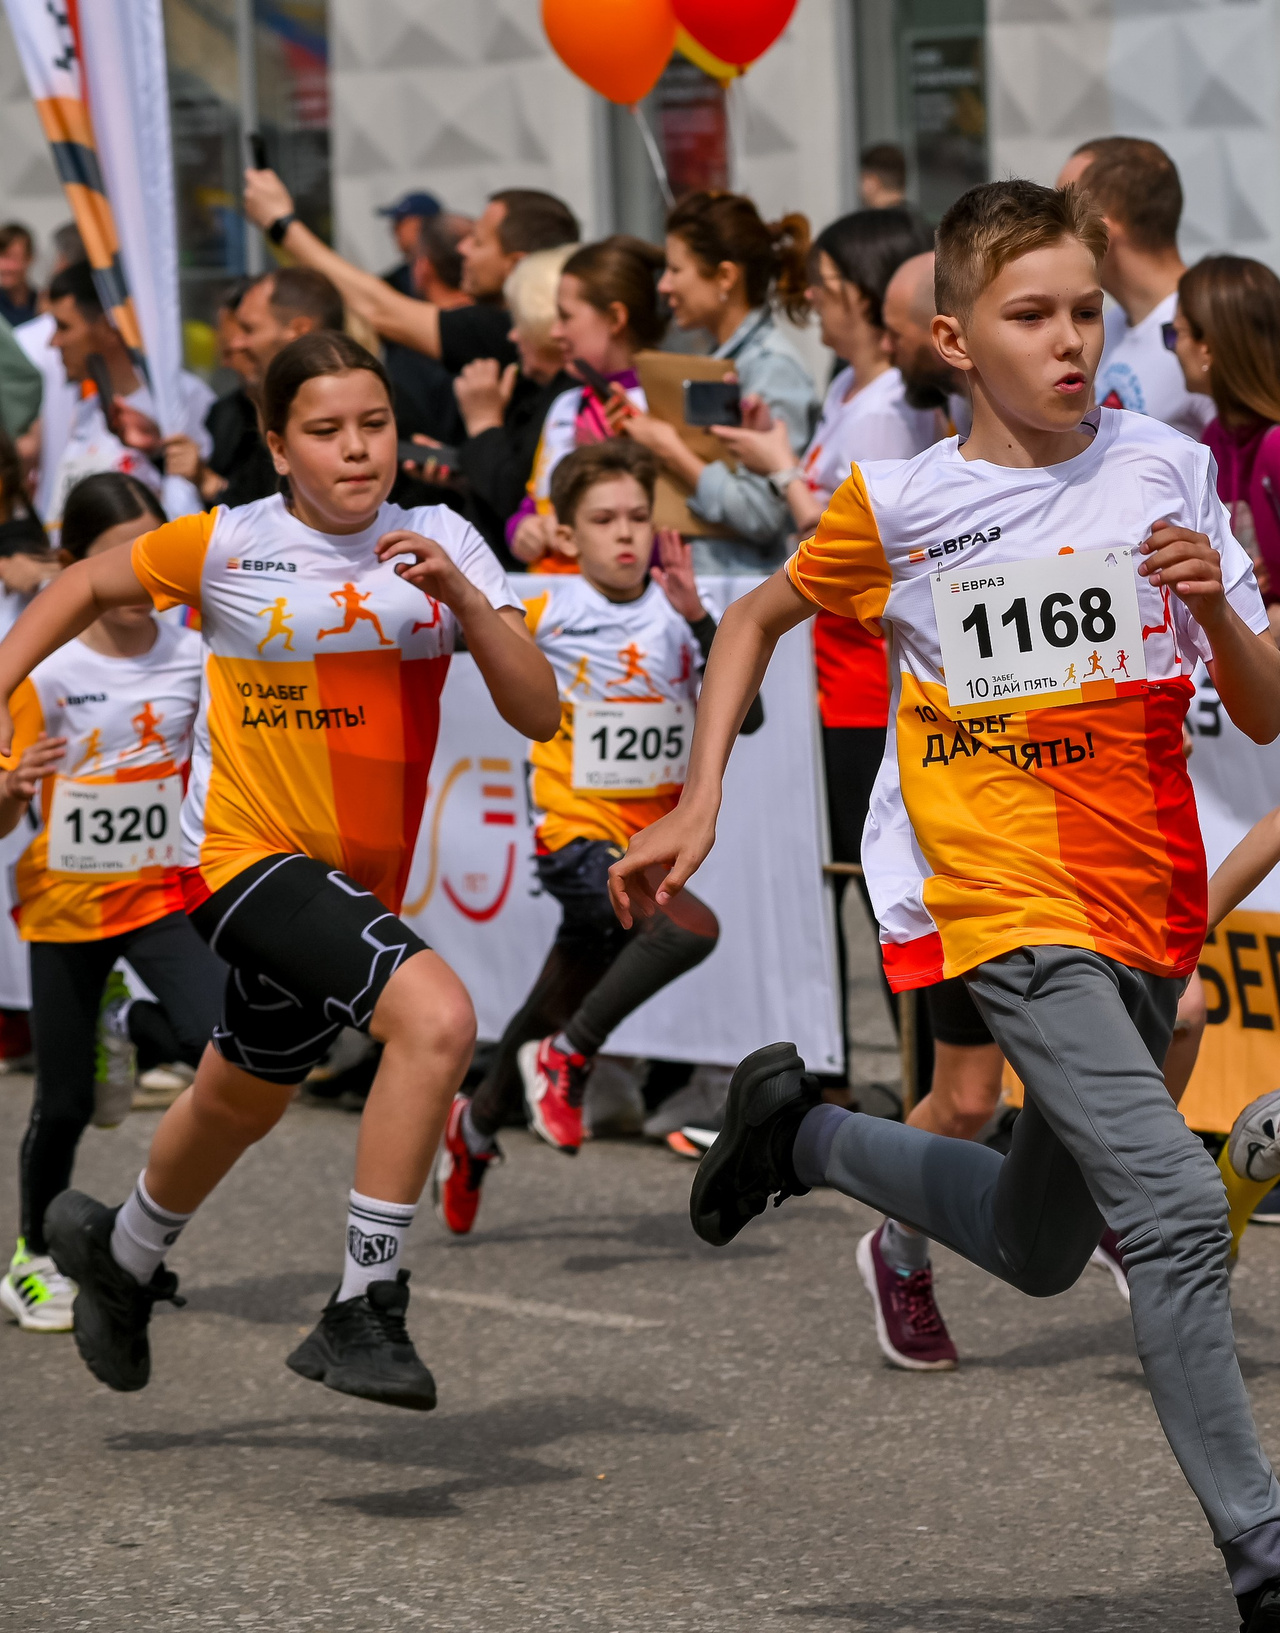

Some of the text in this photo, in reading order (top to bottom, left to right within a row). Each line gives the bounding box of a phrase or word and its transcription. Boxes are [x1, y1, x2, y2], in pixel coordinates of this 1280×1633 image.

[928, 526, 1001, 559] ЕВРАЗ
[242, 560, 297, 573] ЕВРАЗ
[961, 576, 1005, 592] ЕВРАЗ
[962, 587, 1116, 659] 1168
[966, 677, 1058, 699] 10 ДАЙ ПЯТЬ
[992, 673, 1015, 683] ЗАБЕГ
[256, 683, 308, 701] ЗАБЕГ
[242, 704, 366, 729] ДАЙ ПЯТЬ!
[914, 705, 938, 722] 10
[591, 725, 684, 761] 1205
[64, 803, 168, 845] 1320
